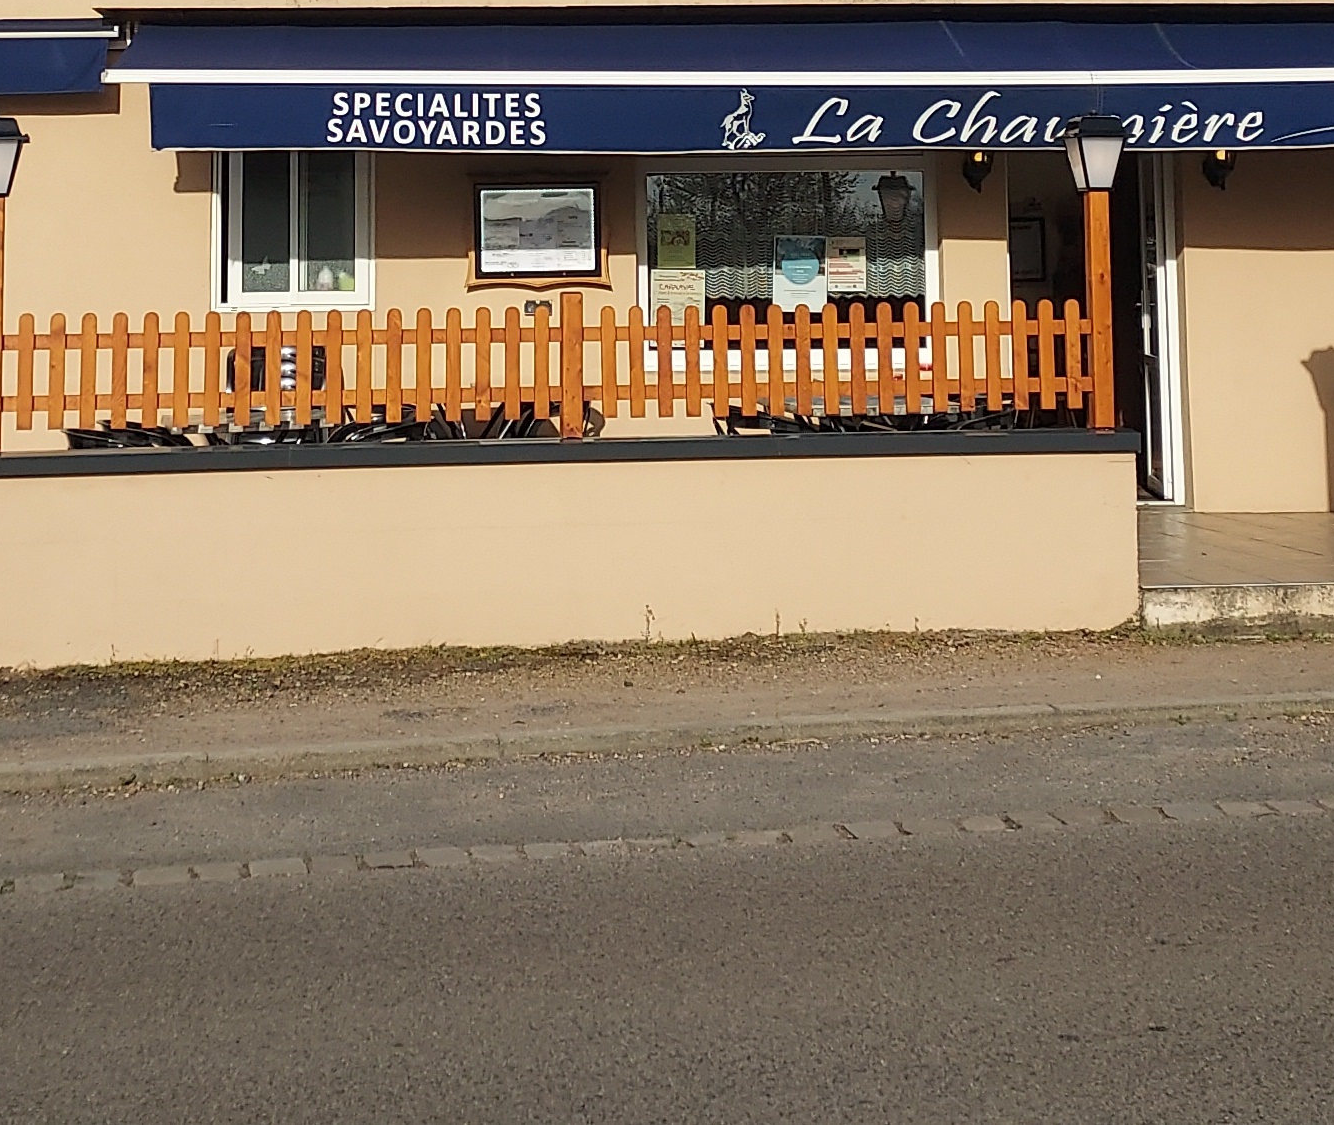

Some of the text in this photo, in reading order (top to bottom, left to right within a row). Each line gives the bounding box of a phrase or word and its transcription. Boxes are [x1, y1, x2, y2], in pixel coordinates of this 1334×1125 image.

[332, 91, 542, 118] SPECIALITES
[326, 118, 546, 146] SAVOYARDES
[791, 96, 884, 145] La
